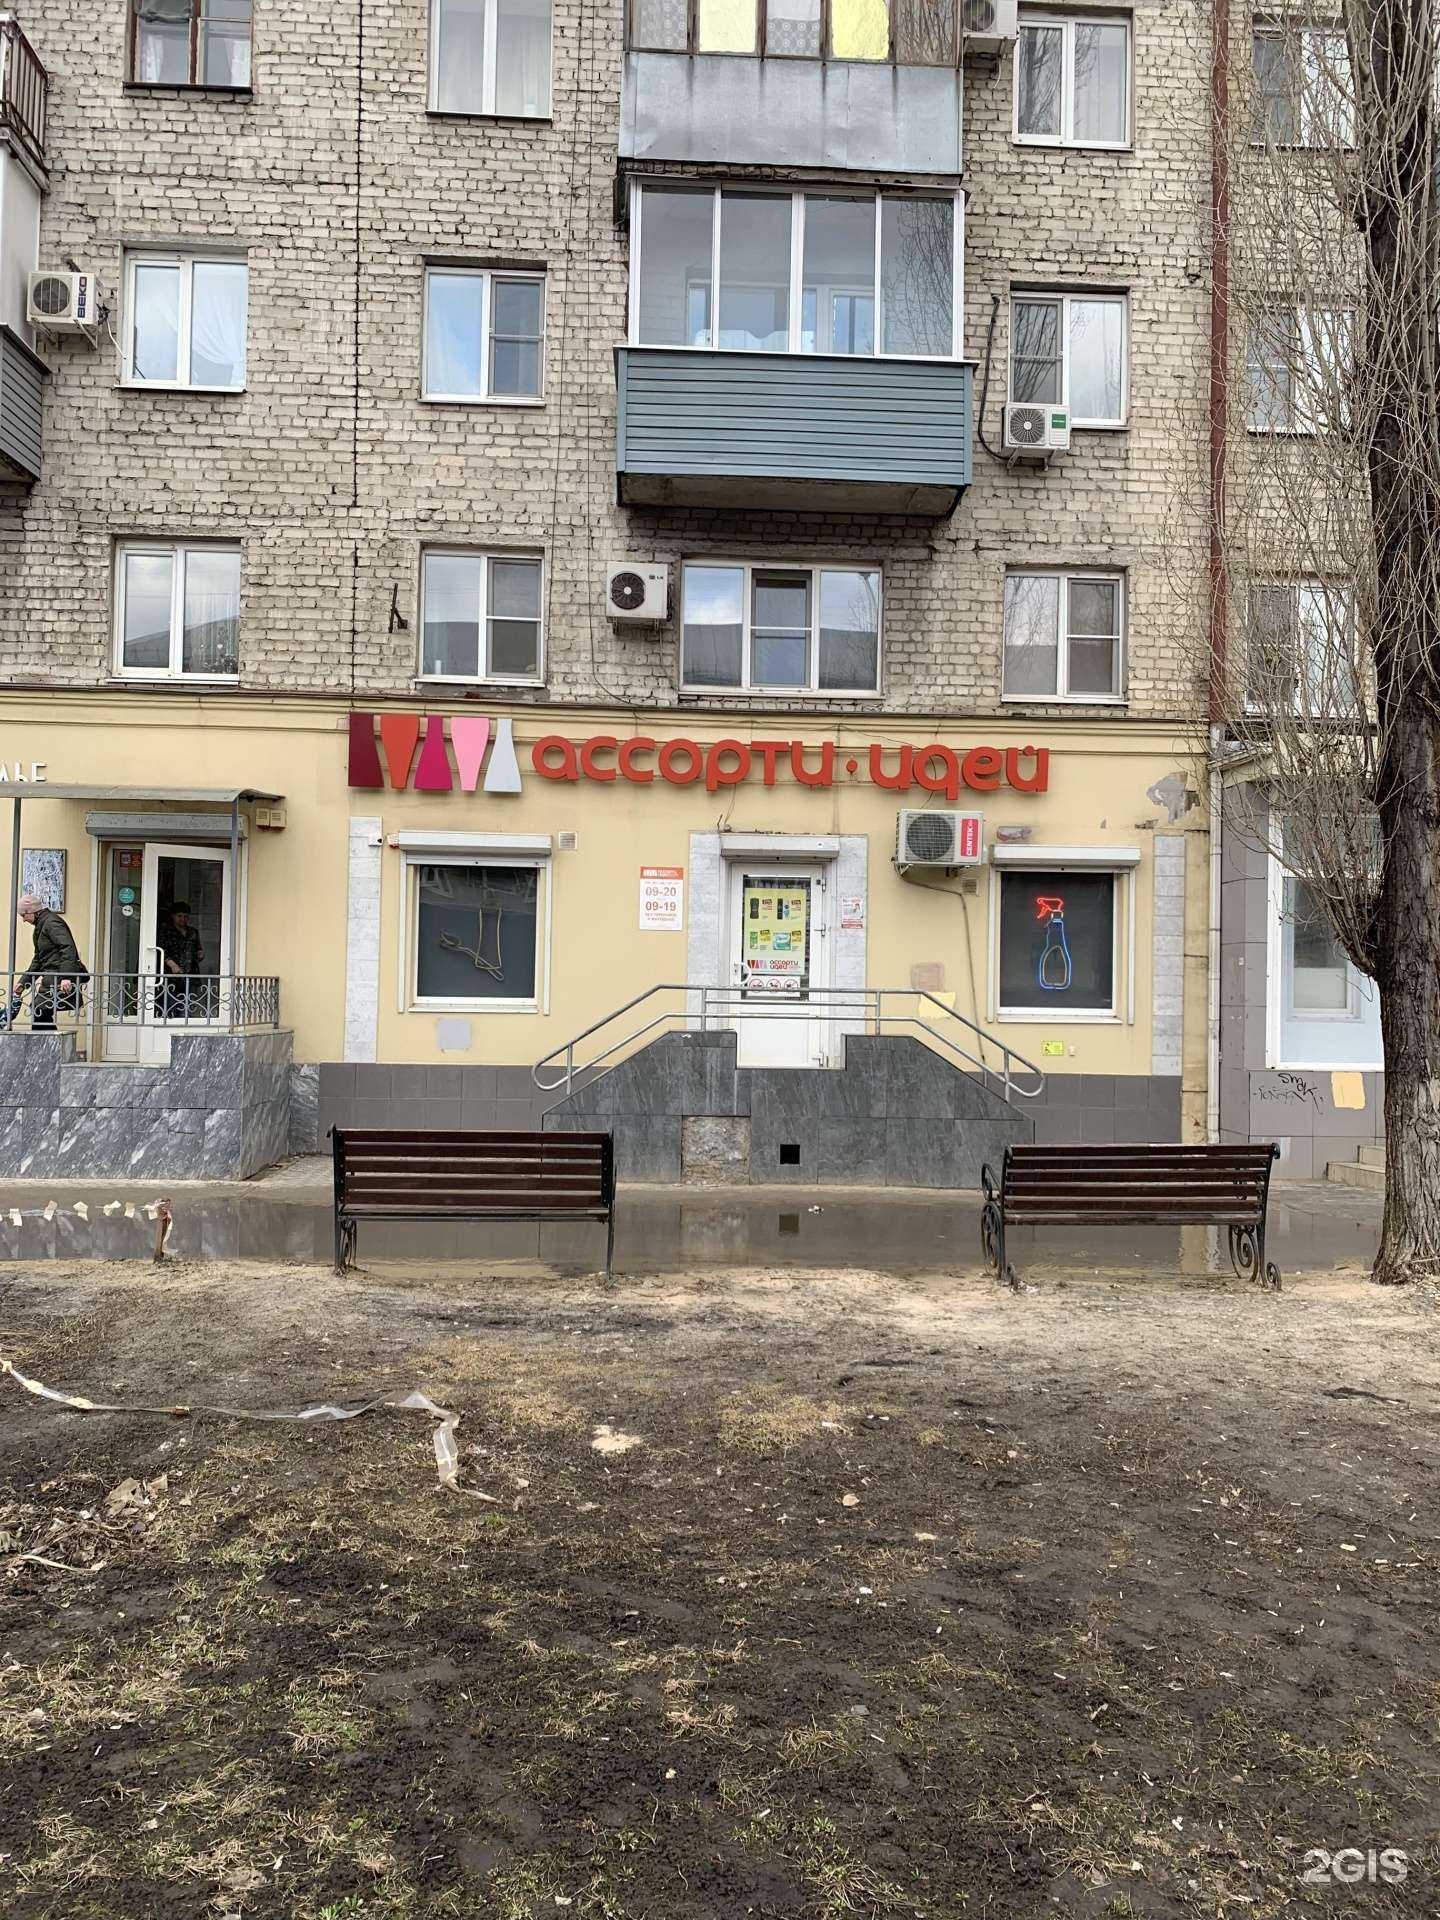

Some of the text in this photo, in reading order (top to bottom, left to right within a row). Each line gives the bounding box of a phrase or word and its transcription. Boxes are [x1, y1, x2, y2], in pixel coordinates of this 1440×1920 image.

[77, 276, 88, 318] BEKO
[645, 886, 677, 897] 09-20
[645, 901, 677, 912] 09-19
